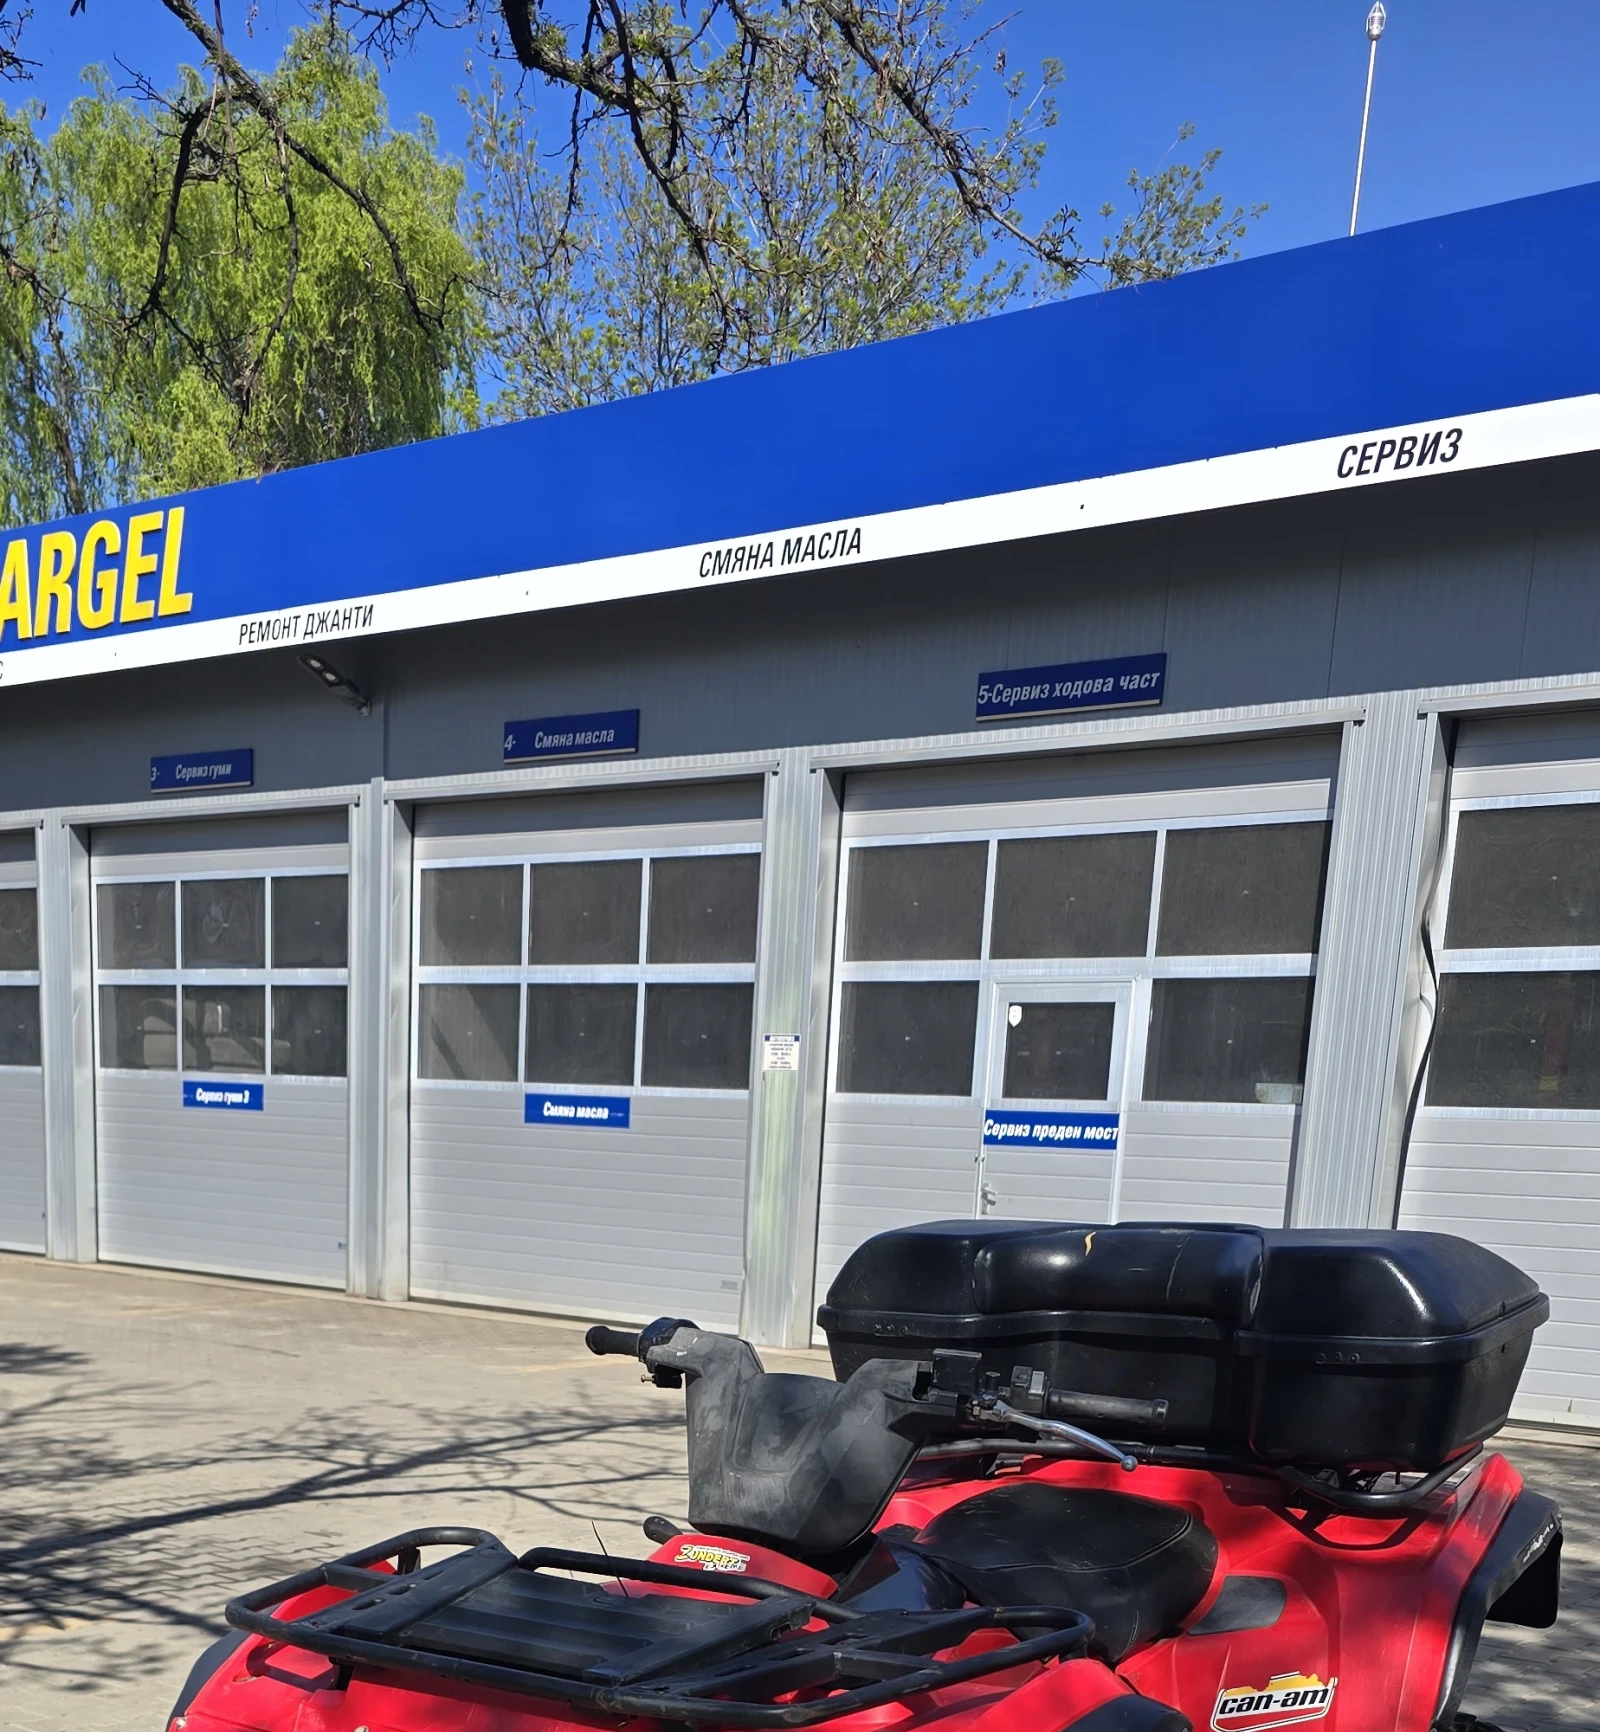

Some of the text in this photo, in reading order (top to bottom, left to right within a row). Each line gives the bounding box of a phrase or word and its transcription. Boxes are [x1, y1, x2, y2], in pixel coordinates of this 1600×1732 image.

[1337, 428, 1463, 479] СЕРВИЗ
[699, 527, 862, 578] СМЯНА МАСЛА
[0, 506, 194, 642] ARGEL
[238, 604, 374, 645] РЕМОНТ ДЖАНТИ
[977, 672, 1161, 707] 5-Сервиз ходова част
[534, 731, 574, 749] Смяна
[574, 729, 615, 745] масла
[175, 764, 208, 782] Сервиз
[209, 764, 232, 780] гуми
[543, 1101, 610, 1120] Смяна масла
[983, 1119, 1120, 1141] Сервиз преден мост
[1219, 1688, 1329, 1715] can-am
